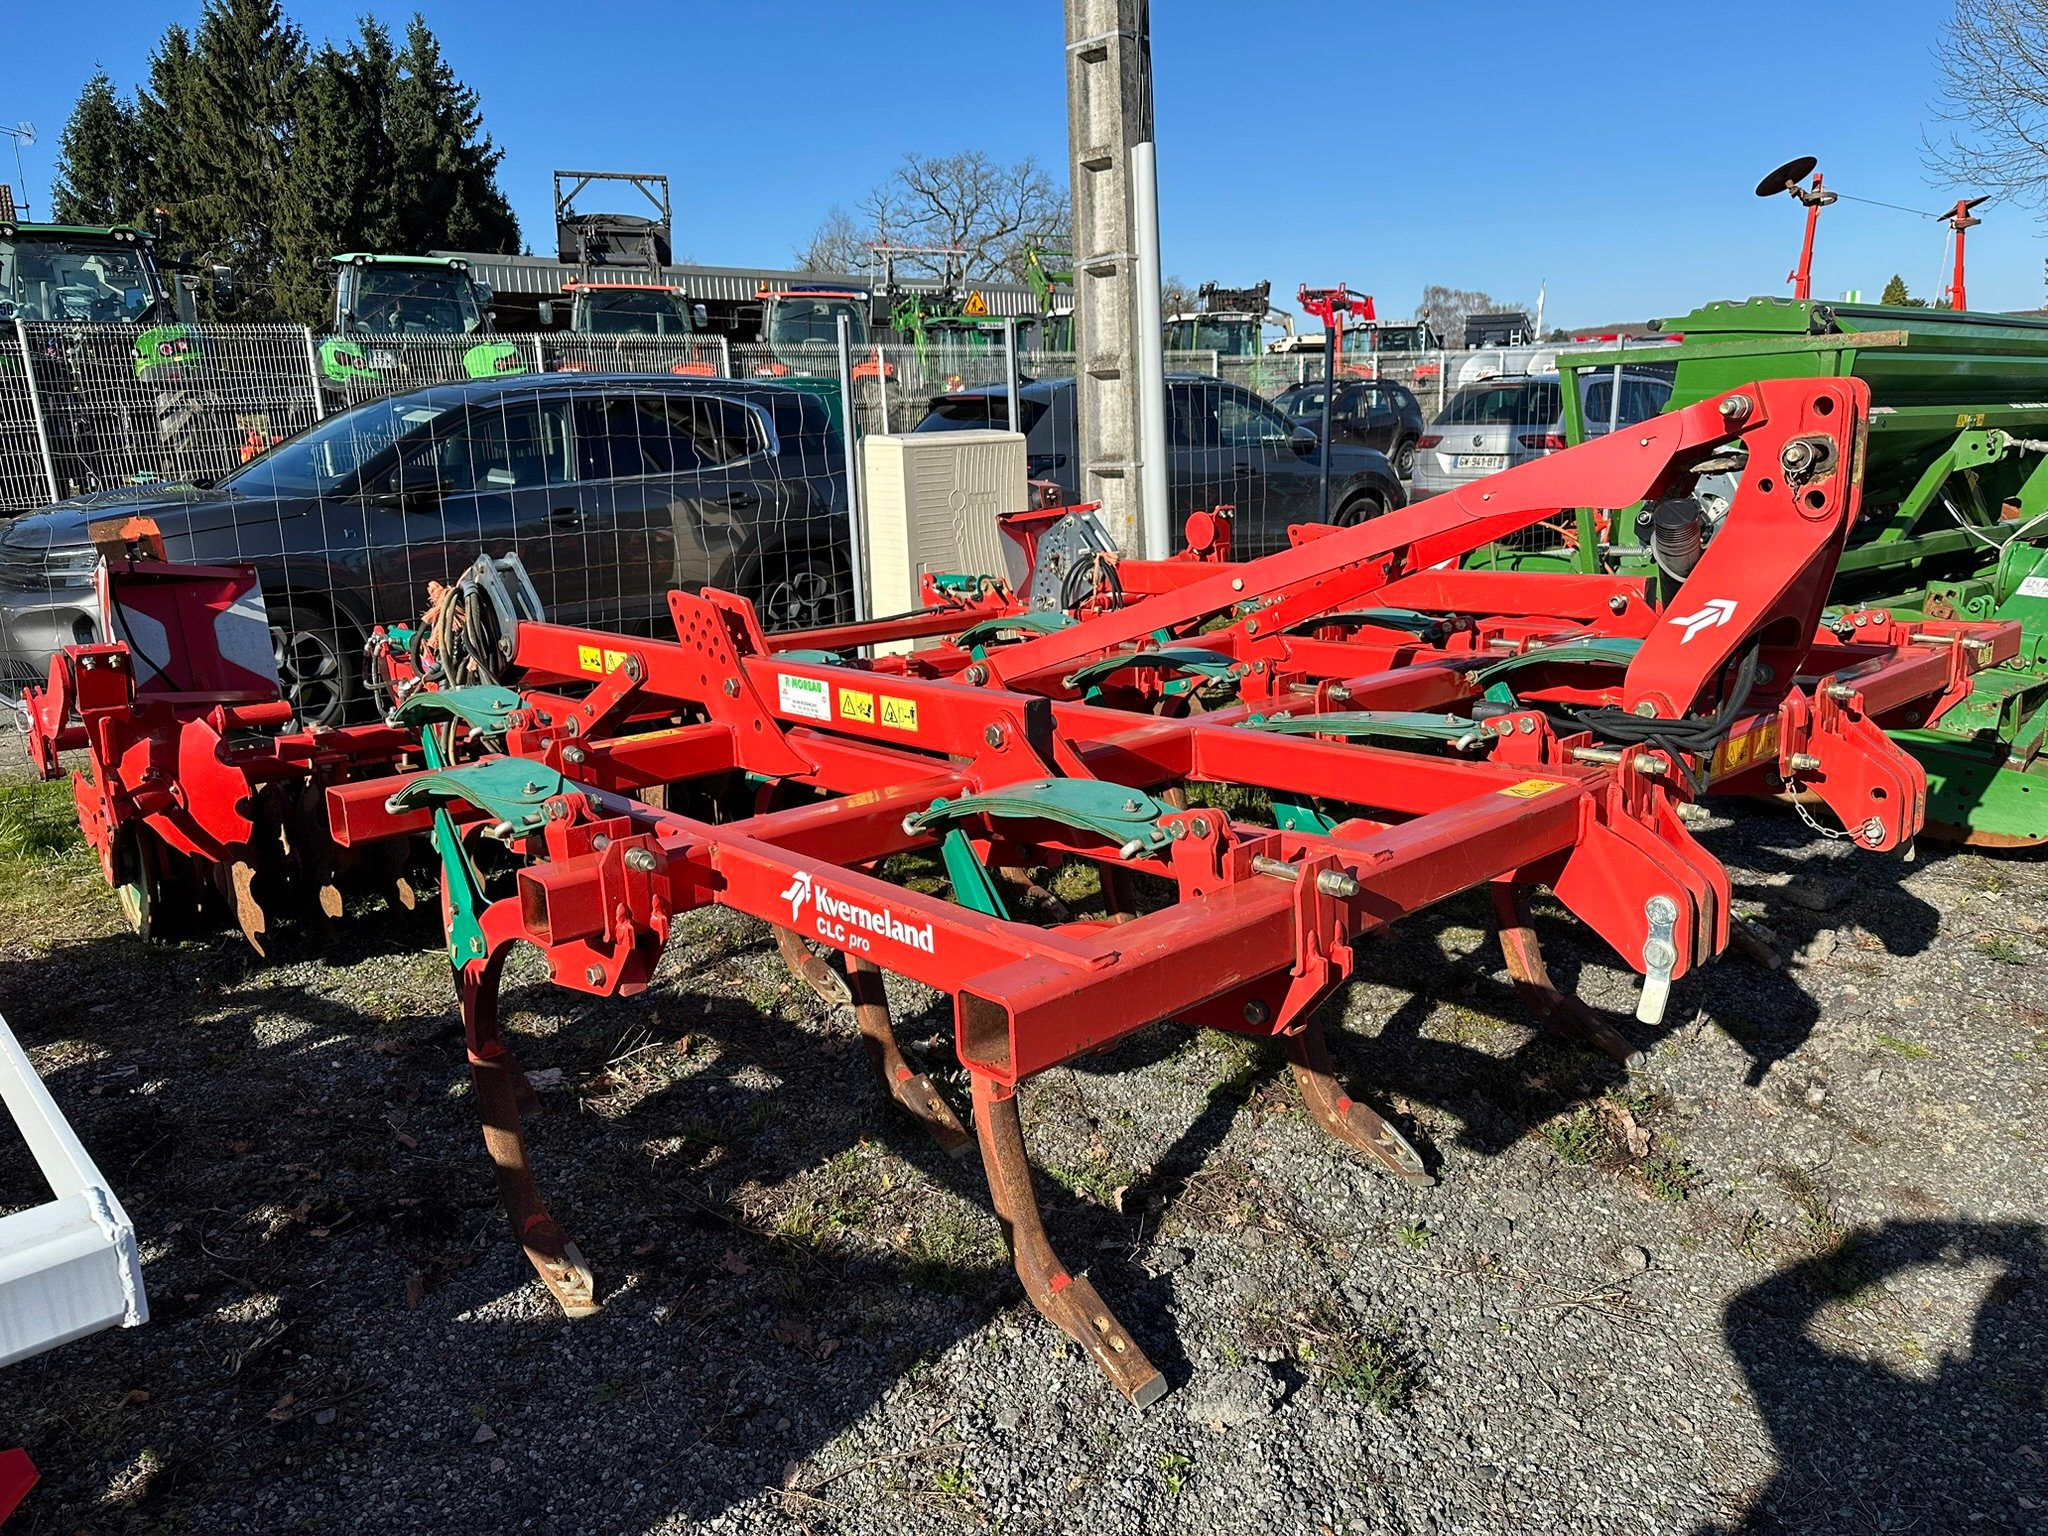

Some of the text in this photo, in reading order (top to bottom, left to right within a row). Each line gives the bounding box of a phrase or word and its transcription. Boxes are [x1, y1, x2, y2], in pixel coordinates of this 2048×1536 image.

[791, 678, 822, 693] MOREAU
[813, 884, 935, 954] Kverneland
[816, 916, 870, 952] CLC pro
